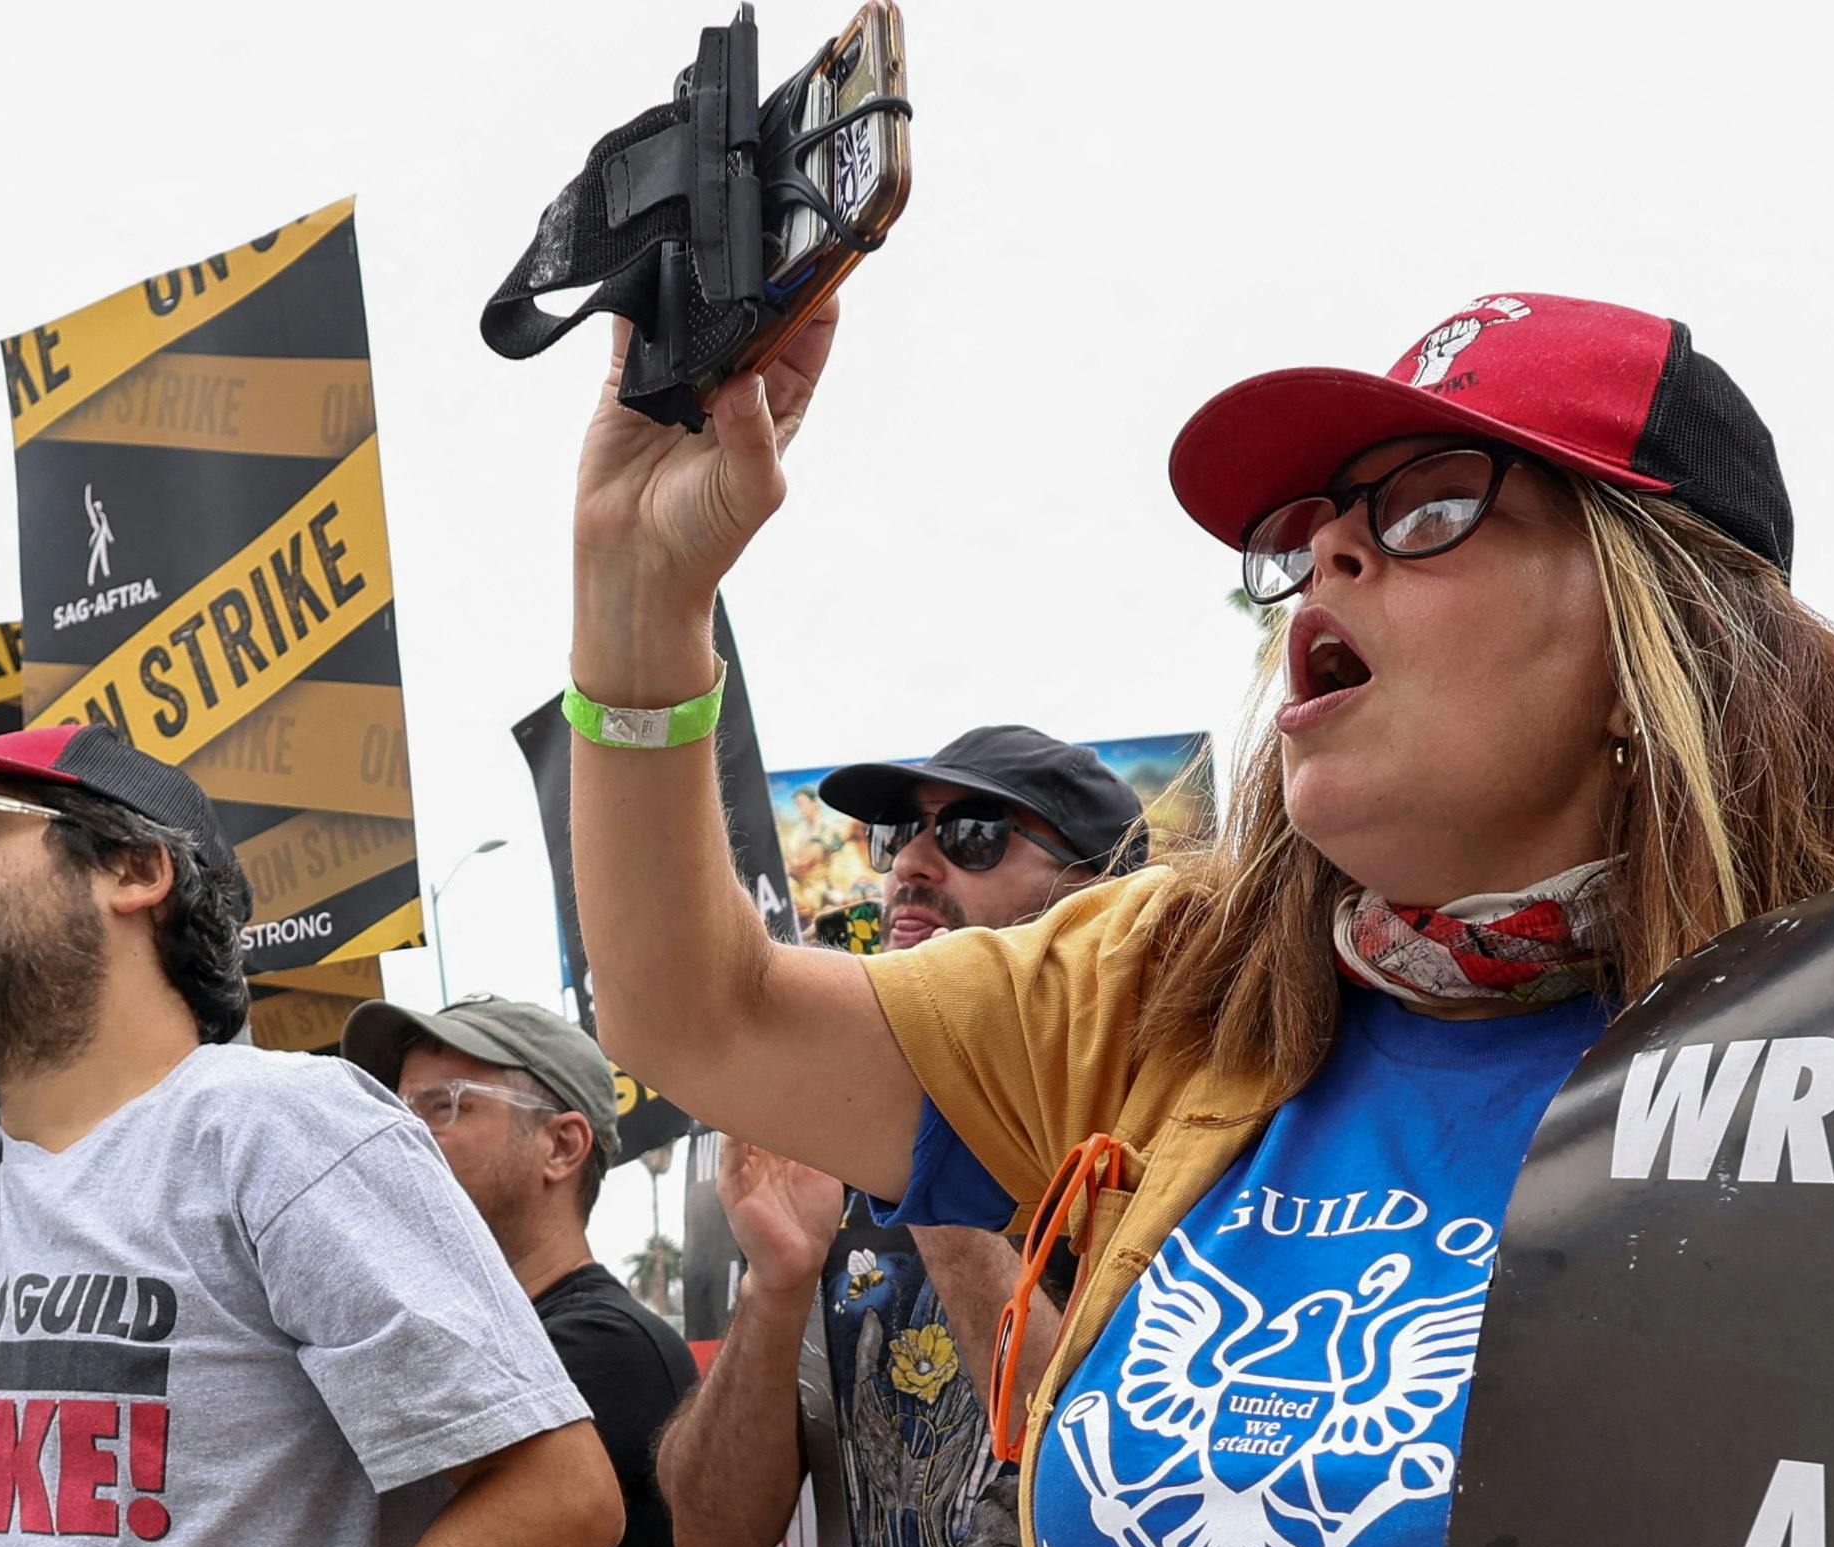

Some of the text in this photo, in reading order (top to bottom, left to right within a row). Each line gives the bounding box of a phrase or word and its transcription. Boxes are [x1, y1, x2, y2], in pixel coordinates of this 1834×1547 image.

[138, 500, 367, 739] STRIKE
[240, 911, 333, 952] STRONG
[14, 1273, 178, 1342] GUILD
[1229, 1392, 1319, 1419] united
[1213, 1434, 1293, 1456] stand
[1245, 1420, 1281, 1436] we
